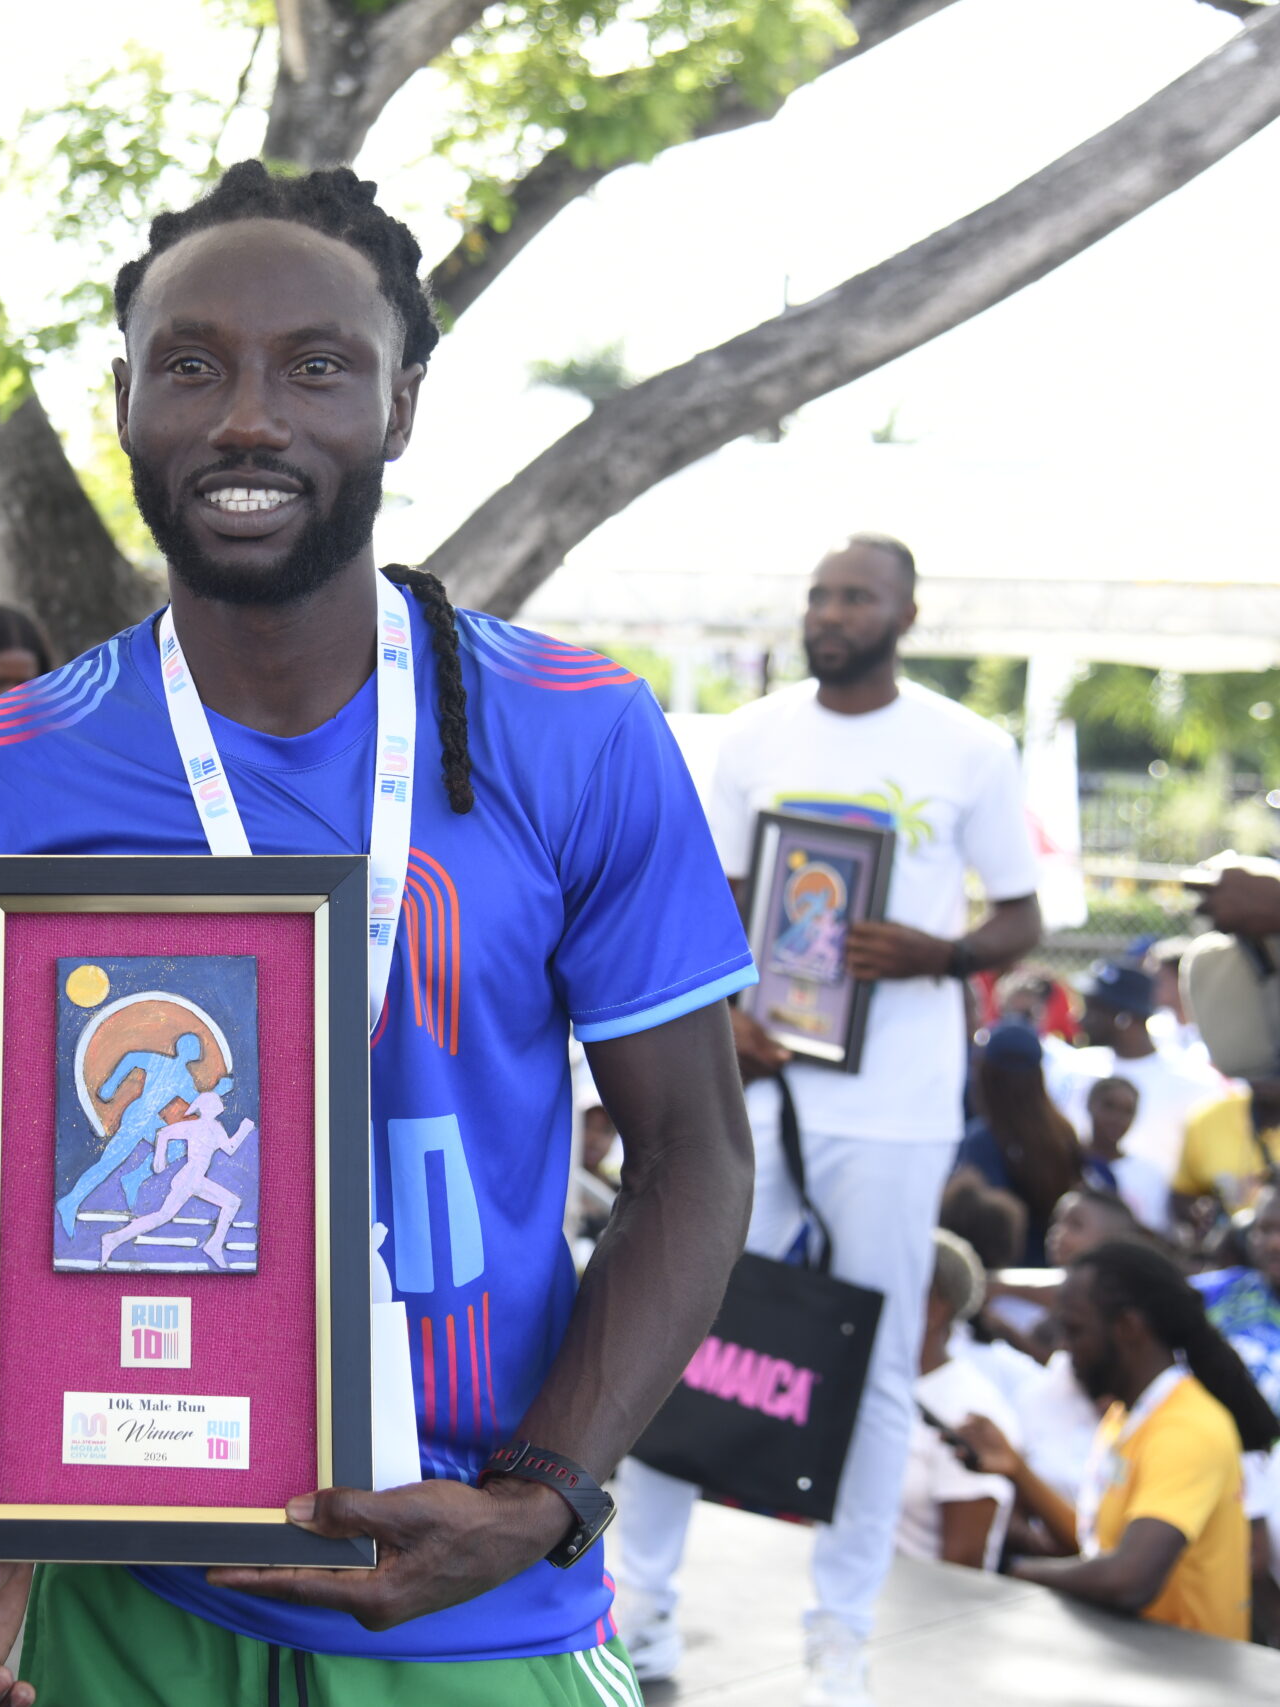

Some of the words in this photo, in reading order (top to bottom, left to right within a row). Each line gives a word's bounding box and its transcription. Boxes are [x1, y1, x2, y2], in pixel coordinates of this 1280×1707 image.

[131, 1304, 178, 1329] RUN
[131, 1328, 162, 1359] 10
[108, 1398, 133, 1411] 10k
[139, 1399, 171, 1412] Male
[177, 1400, 206, 1413] Run
[117, 1418, 194, 1443] Winner
[207, 1420, 240, 1438] RUN
[143, 1451, 168, 1462] 2026
[207, 1438, 228, 1459] 10
